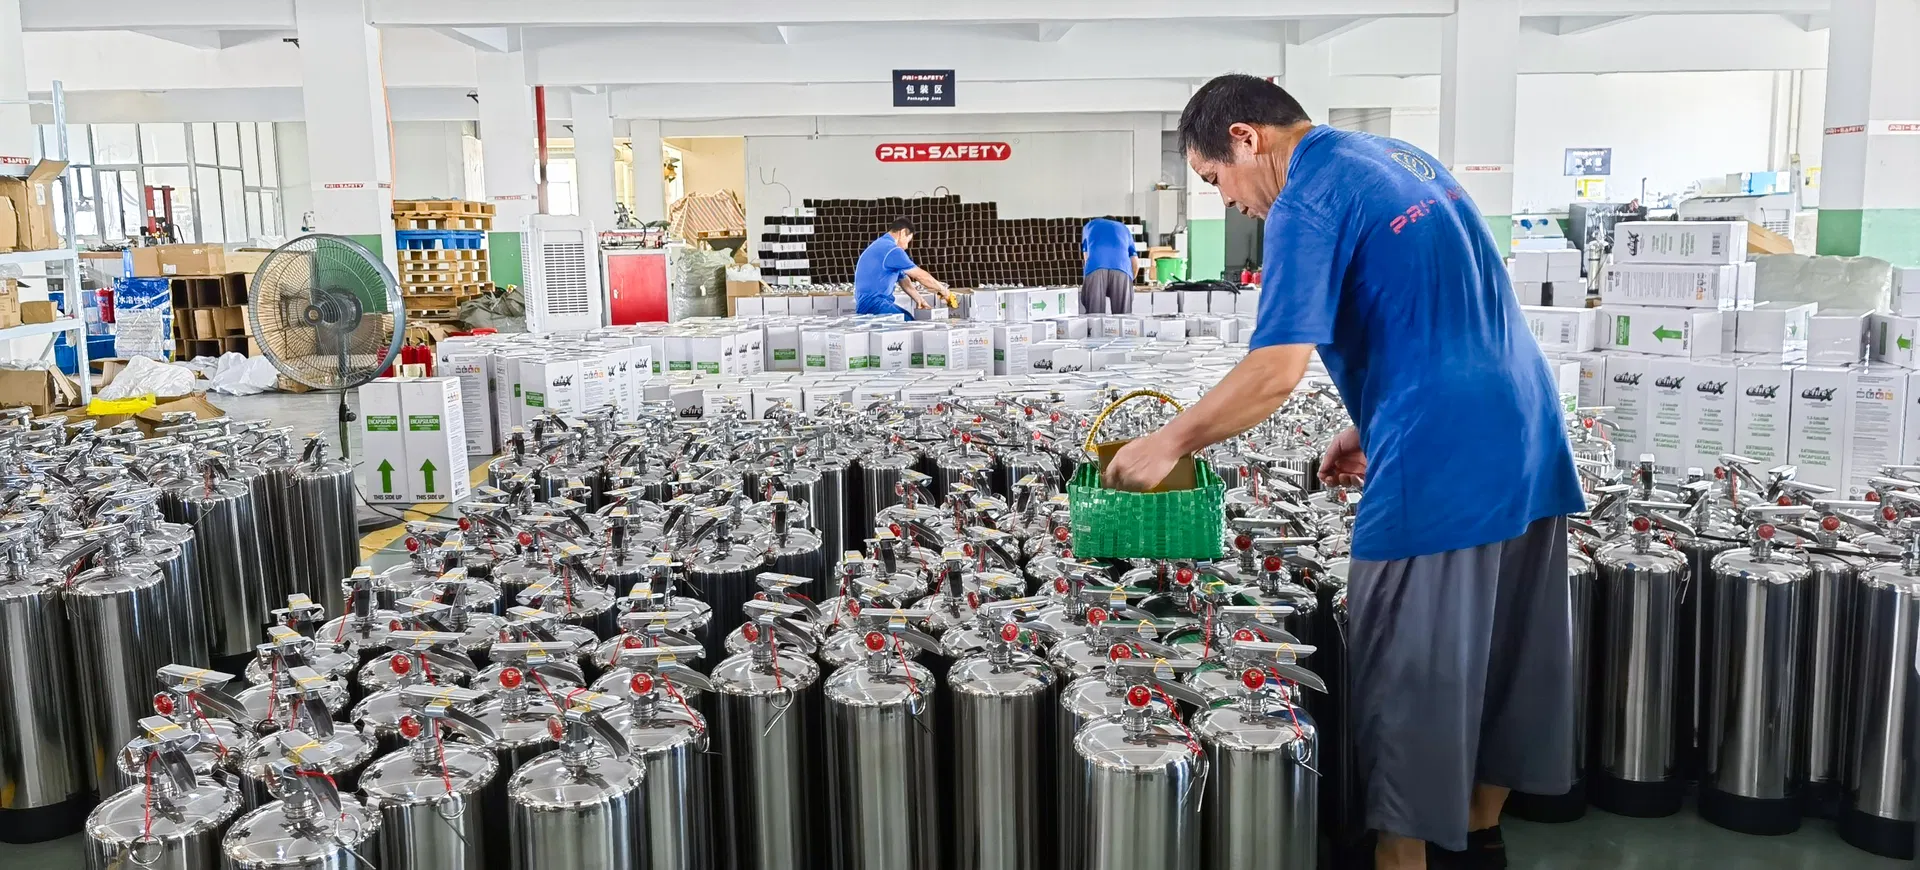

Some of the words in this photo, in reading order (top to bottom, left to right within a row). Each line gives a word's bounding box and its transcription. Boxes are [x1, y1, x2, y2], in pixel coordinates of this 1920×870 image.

[906, 84, 943, 94] 包装区
[880, 145, 1006, 159] PRI-SAFETY
